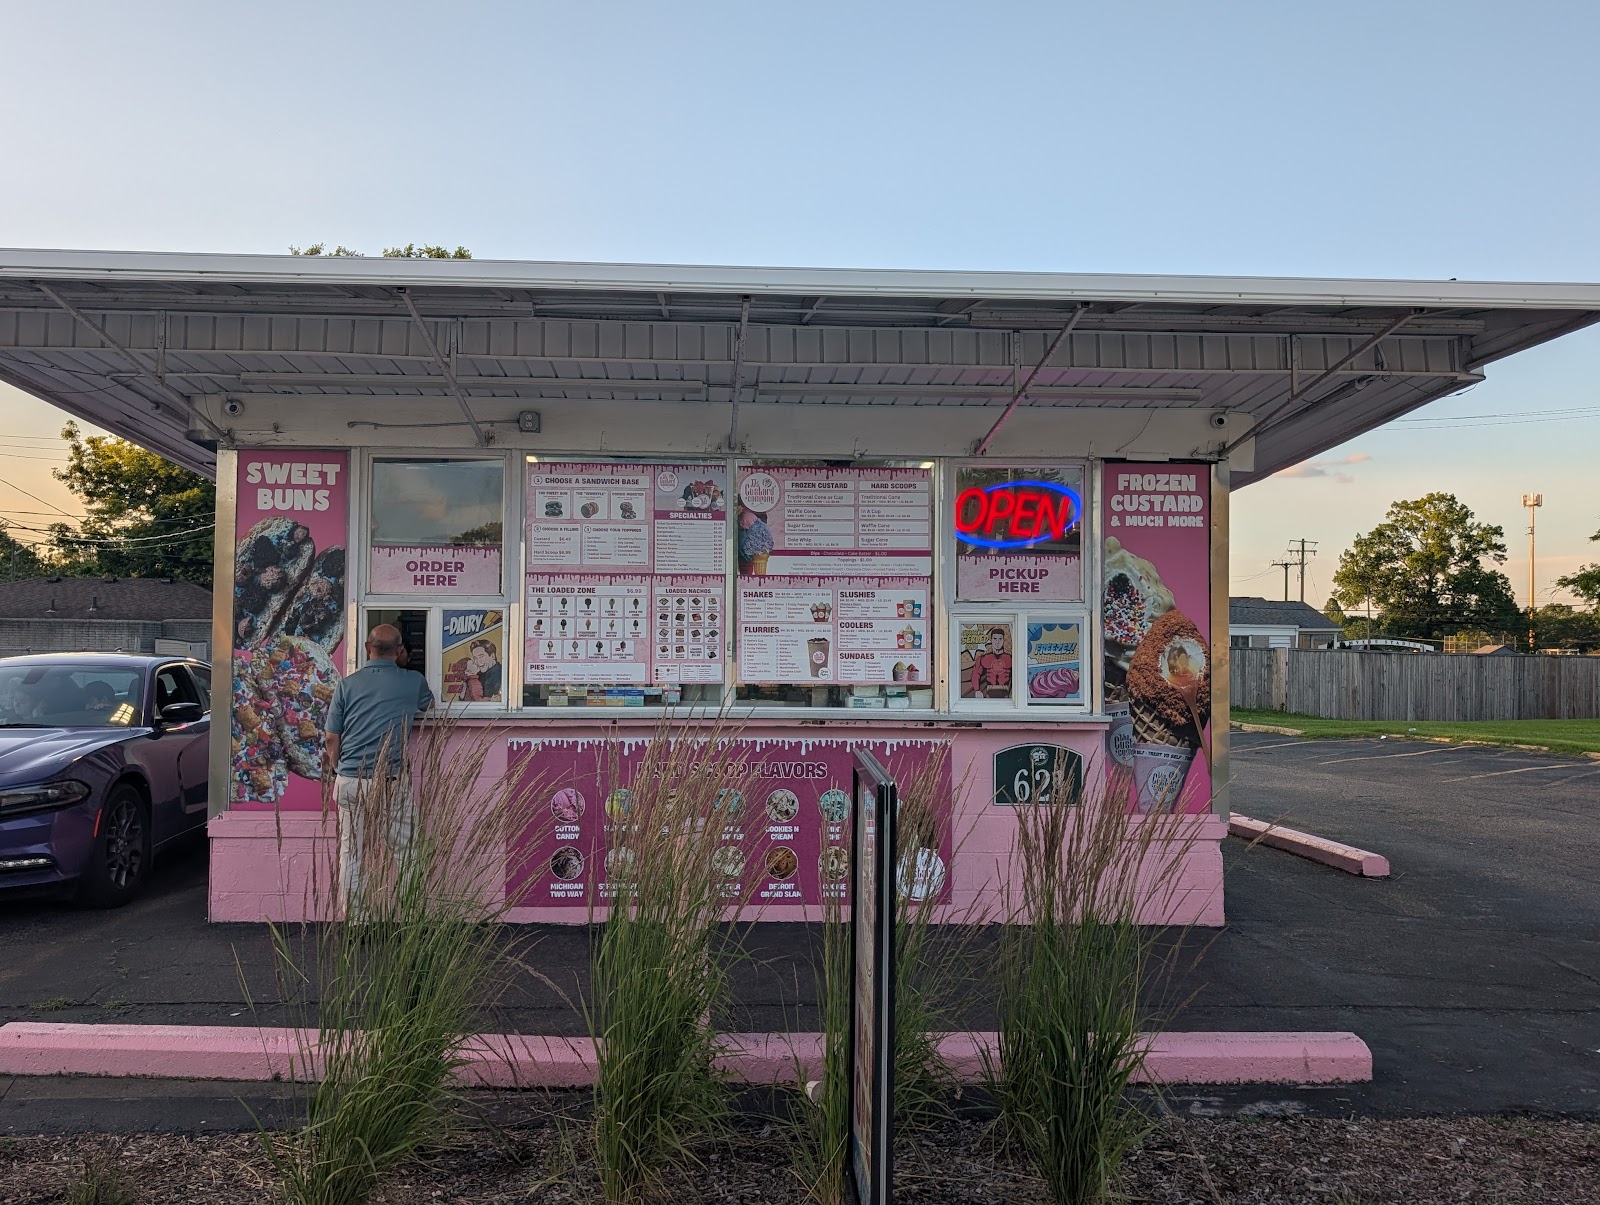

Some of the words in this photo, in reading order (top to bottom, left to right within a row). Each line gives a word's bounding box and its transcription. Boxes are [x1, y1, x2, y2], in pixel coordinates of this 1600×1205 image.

[246, 462, 340, 485] SWEET
[1117, 473, 1197, 492] FROZEN
[257, 488, 330, 511] BUNS
[1110, 494, 1204, 513] CUSTARD
[669, 512, 713, 520] SPECIALTIES
[955, 487, 1071, 540] OPEN
[1110, 515, 1121, 527] &
[1125, 515, 1164, 527] MUCH
[1167, 515, 1204, 528] MORE
[405, 560, 465, 573] ORDER
[413, 574, 457, 586] HERE
[989, 568, 1049, 580] PICKUP
[998, 582, 1040, 593] HERE
[1034, 643, 1078, 655] FREEZE!!
[1114, 736, 1134, 750] Cust
[751, 762, 828, 778] FLAVORS
